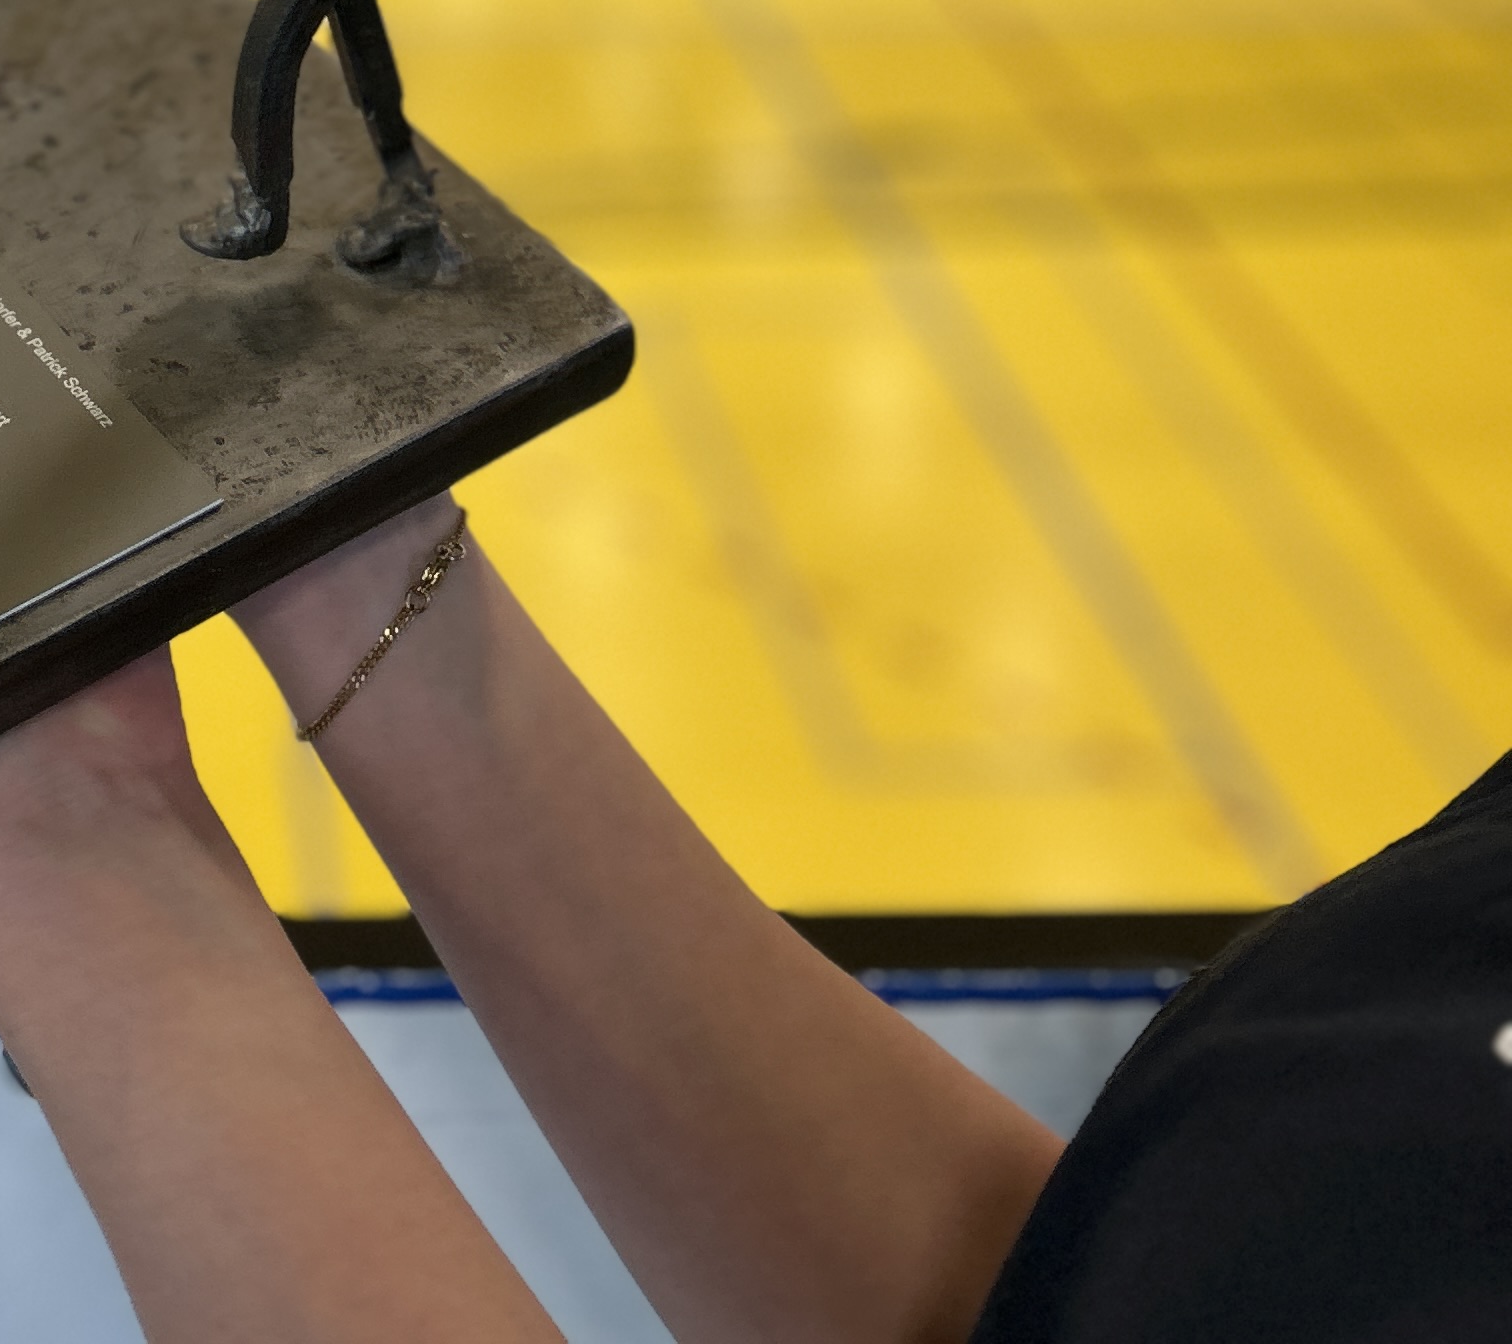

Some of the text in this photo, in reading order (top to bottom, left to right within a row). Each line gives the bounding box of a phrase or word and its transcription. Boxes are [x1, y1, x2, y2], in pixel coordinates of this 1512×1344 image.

[16, 327, 32, 340] &
[25, 337, 67, 379] Patrick
[63, 376, 113, 429] Schwarz
